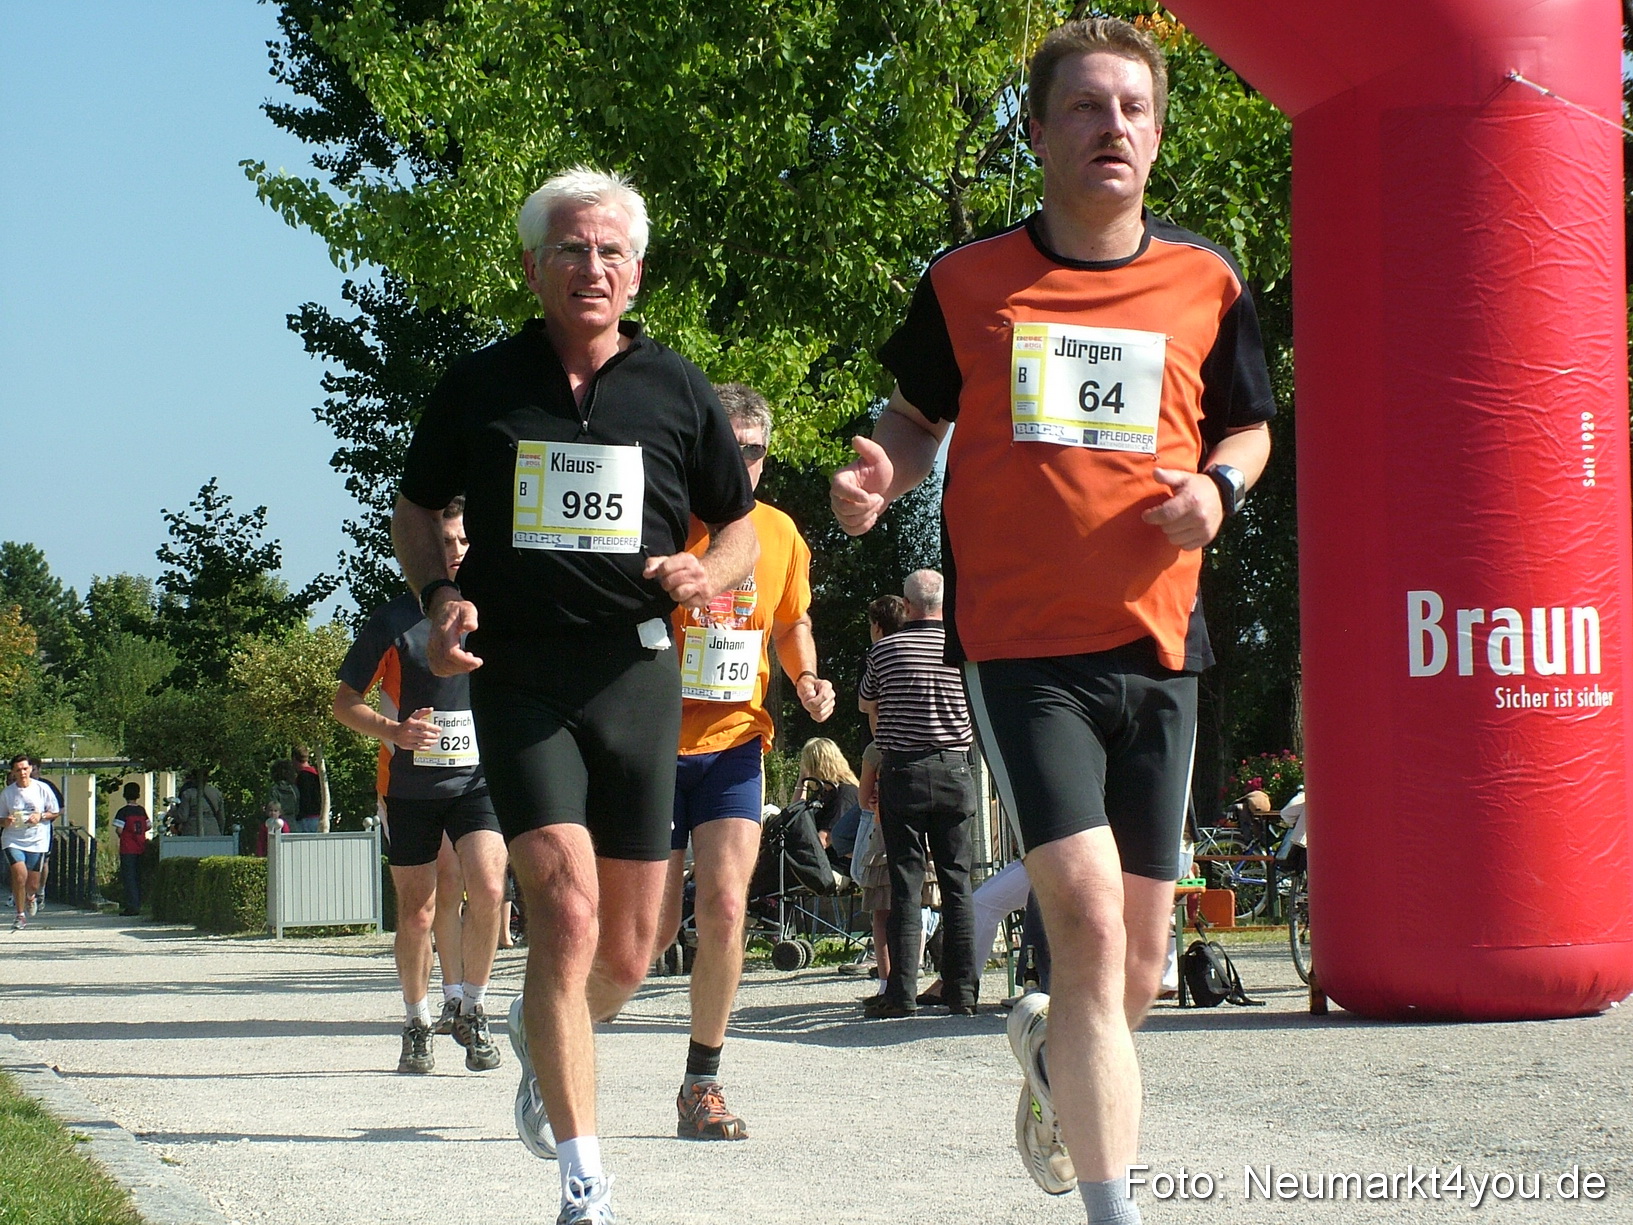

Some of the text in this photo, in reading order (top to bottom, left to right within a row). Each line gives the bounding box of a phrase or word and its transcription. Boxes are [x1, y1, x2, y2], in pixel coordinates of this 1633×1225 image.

[1054, 335, 1122, 364] Jürgen
[1018, 366, 1027, 384] B
[1078, 380, 1125, 414] 64
[1099, 430, 1154, 445] PFLEIDERER
[1580, 411, 1595, 450] 1929
[550, 452, 603, 474] Klaus-
[519, 481, 527, 496] B
[562, 490, 623, 520] 985
[515, 531, 562, 544] BOCK
[593, 536, 639, 547] PFLEIDERER
[709, 635, 745, 650] Johann
[1406, 590, 1601, 678] Braun
[686, 653, 693, 665] C
[716, 661, 749, 681] 150
[1494, 683, 1614, 709] Sicher ist sicher
[433, 716, 472, 728] Friedrich
[440, 735, 471, 751] 629
